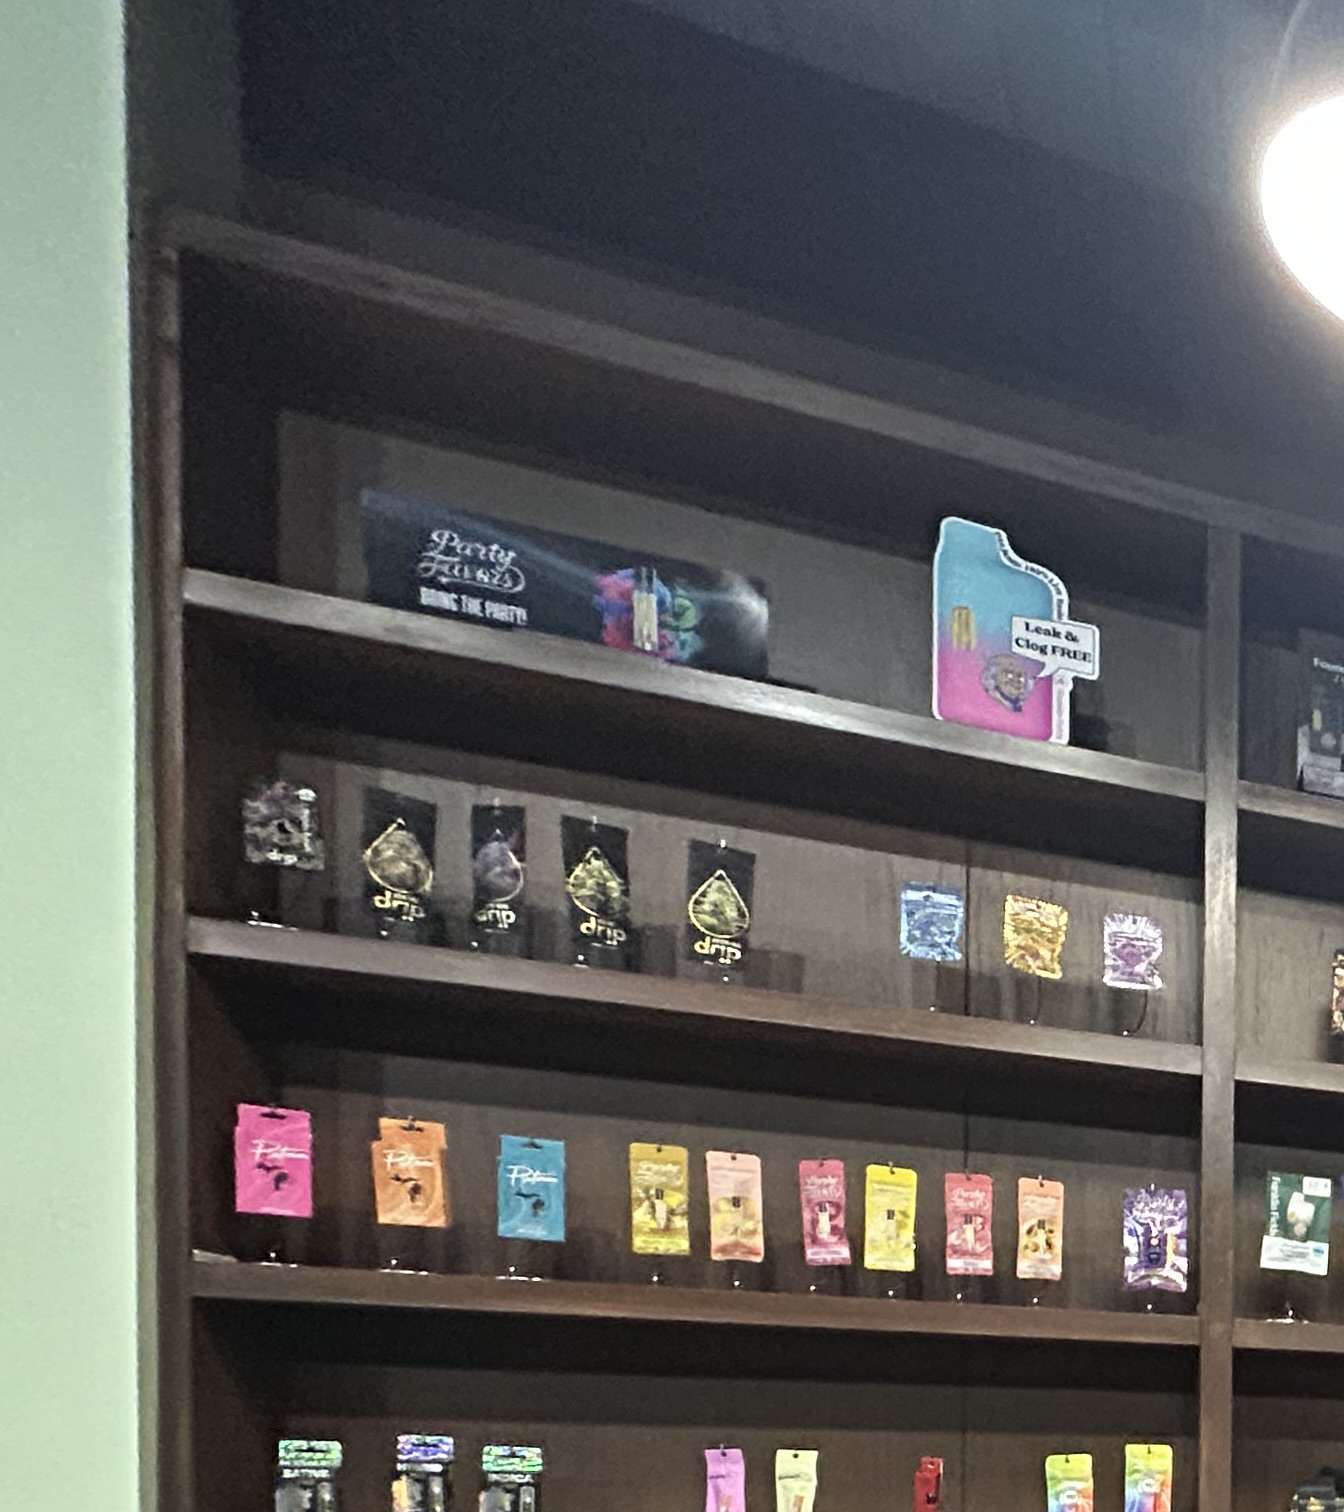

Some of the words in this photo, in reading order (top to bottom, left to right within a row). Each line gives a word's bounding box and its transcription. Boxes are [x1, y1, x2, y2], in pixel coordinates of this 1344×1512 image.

[1023, 621, 1062, 641] Leak
[1015, 637, 1048, 656] Clog
[1051, 645, 1092, 664] FREE
[374, 890, 425, 923] drip
[579, 916, 628, 946] drip
[694, 936, 742, 964] drip
